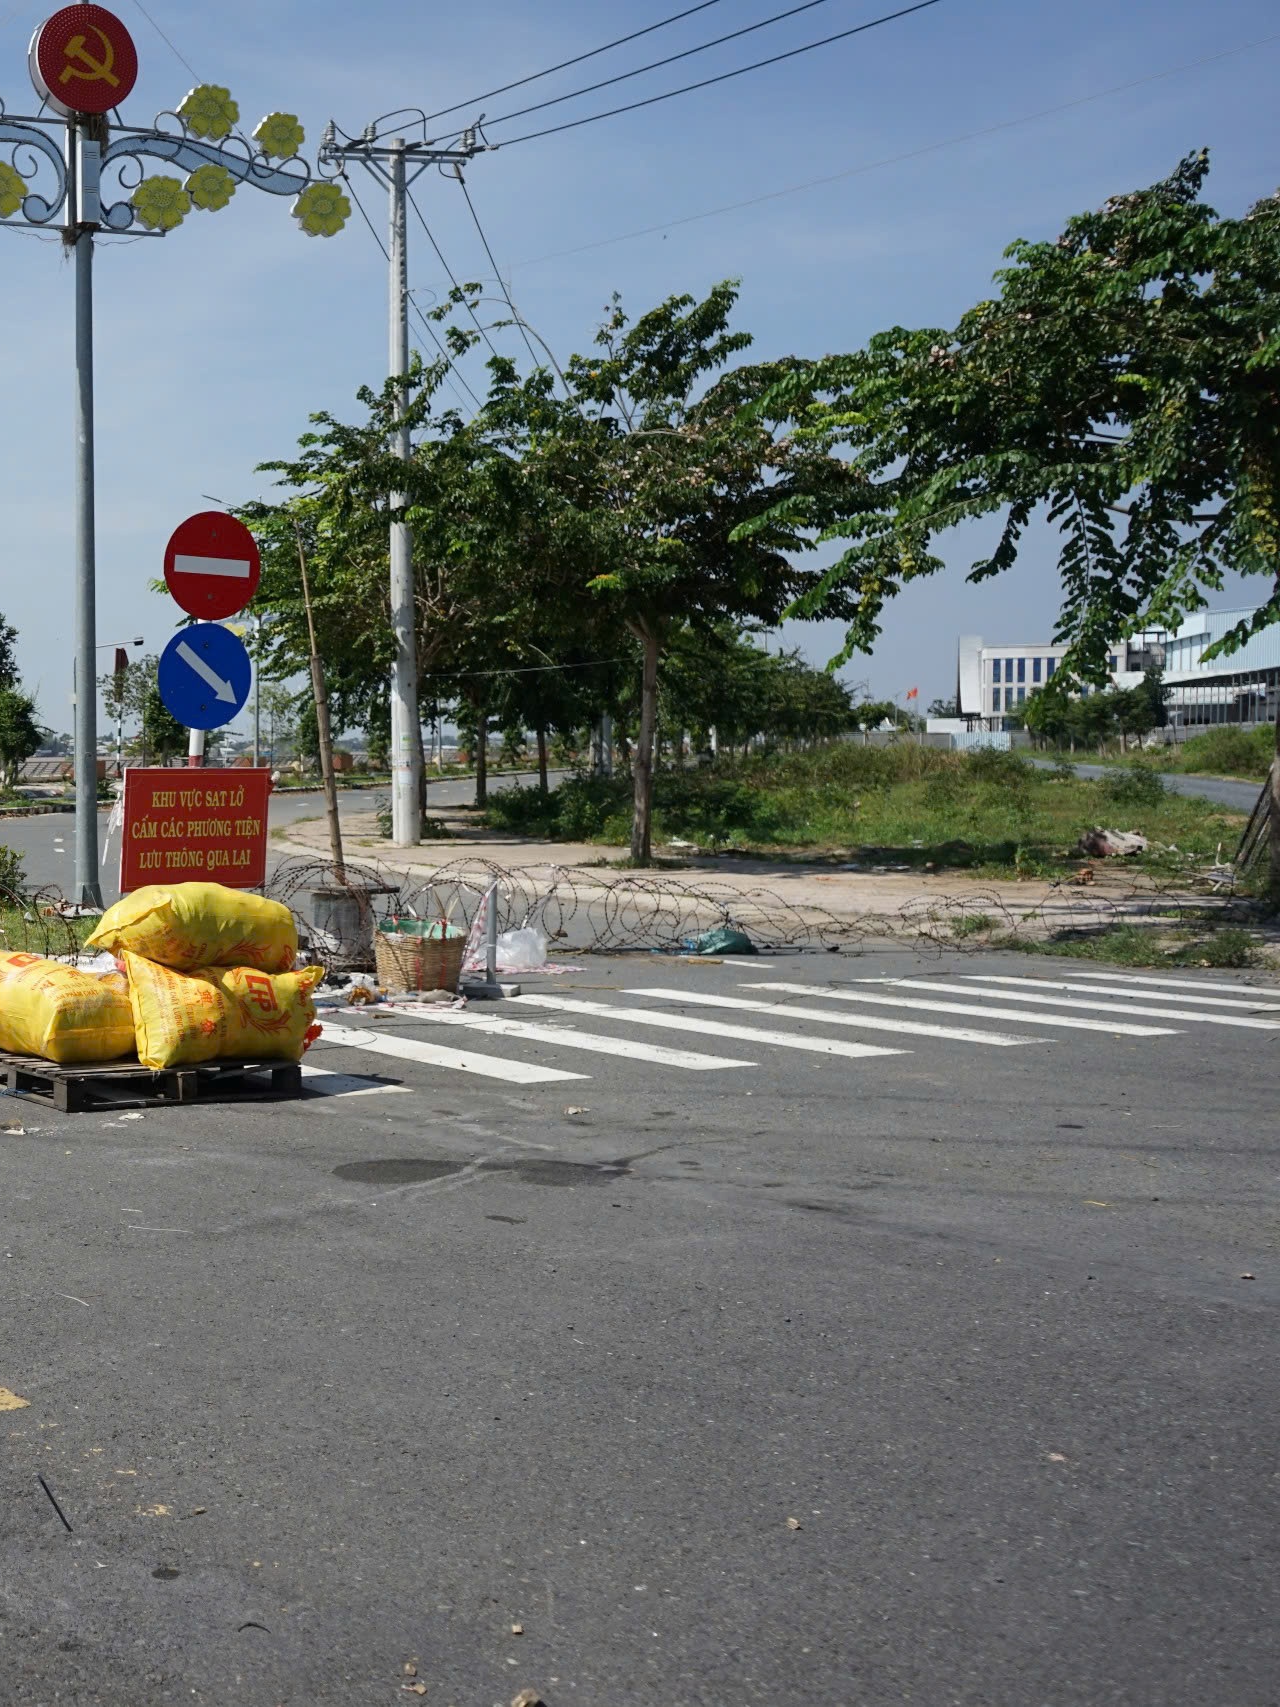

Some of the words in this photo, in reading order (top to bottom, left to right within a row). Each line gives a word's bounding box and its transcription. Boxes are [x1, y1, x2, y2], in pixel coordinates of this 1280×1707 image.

[152, 791, 176, 808] KHU
[180, 788, 203, 811] VỰC
[206, 791, 228, 810] SẠT
[230, 785, 245, 806] LỞ
[132, 815, 158, 838] CẤM
[161, 817, 184, 838] CÁC
[187, 818, 231, 837] PHƯƠNG
[235, 816, 261, 839] TIỆN
[139, 851, 162, 868] LƯU
[165, 847, 203, 868] THÔNG
[207, 850, 230, 870] QUA
[232, 850, 251, 869] LẠI
